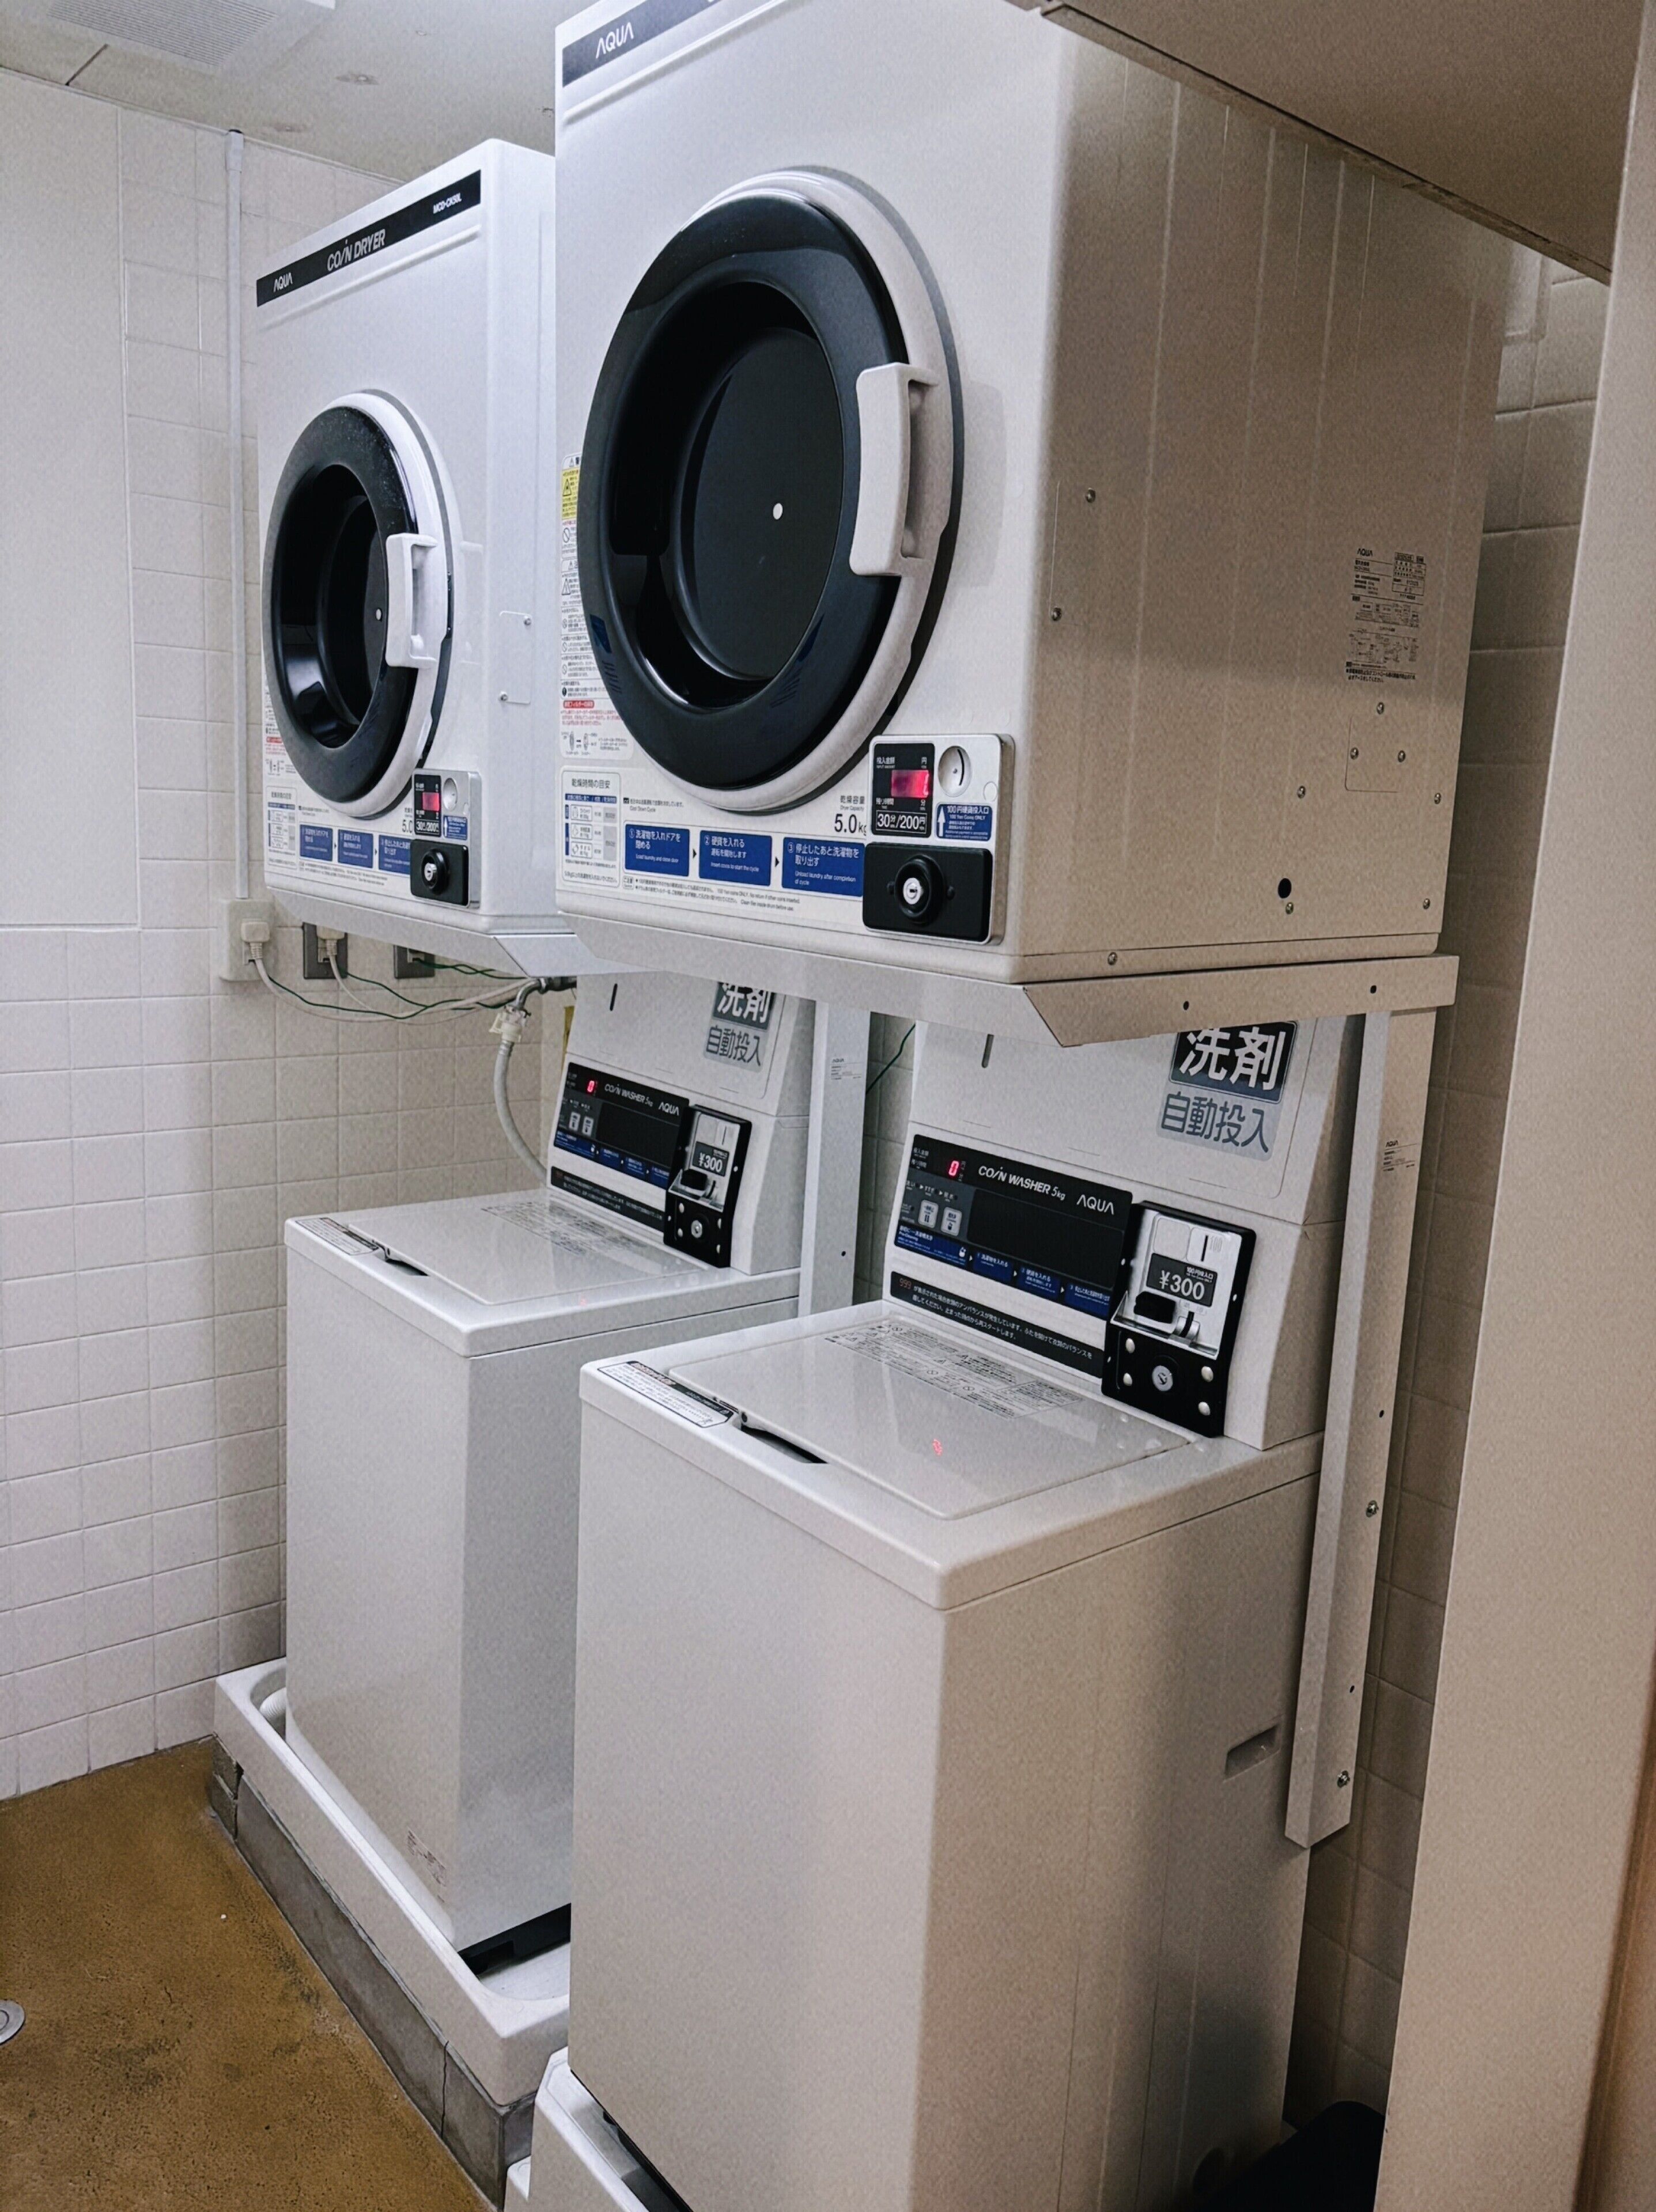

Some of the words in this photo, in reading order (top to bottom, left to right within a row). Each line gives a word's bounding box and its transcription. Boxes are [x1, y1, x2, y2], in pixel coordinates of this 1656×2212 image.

[596, 22, 633, 59] AQUA
[273, 272, 293, 292] AQUA
[354, 229, 386, 257] DRYER
[1357, 548, 1373, 557] AQUA
[572, 778, 611, 789] 乾燥時間の目安
[840, 795, 865, 804] 乾燥容量
[796, 843, 860, 859] 停止したあと洗濯物を
[795, 855, 820, 866] 取り出す
[809, 872, 823, 880] laundry
[833, 874, 856, 882] completion
[706, 1025, 761, 1066] 自動投入
[1179, 1027, 1287, 1090] 洗剤
[658, 1101, 679, 1116] AQUA
[1161, 1092, 1269, 1153] 自動投入
[1386, 1139, 1399, 1147] AQUA
[699, 1152, 723, 1173] ¥300
[948, 1160, 960, 1177] 0
[1008, 1173, 1052, 1195] WASHER
[1076, 1194, 1115, 1215] AQUA
[899, 1278, 912, 1290] 999
[1158, 1269, 1205, 1301] ¥300
